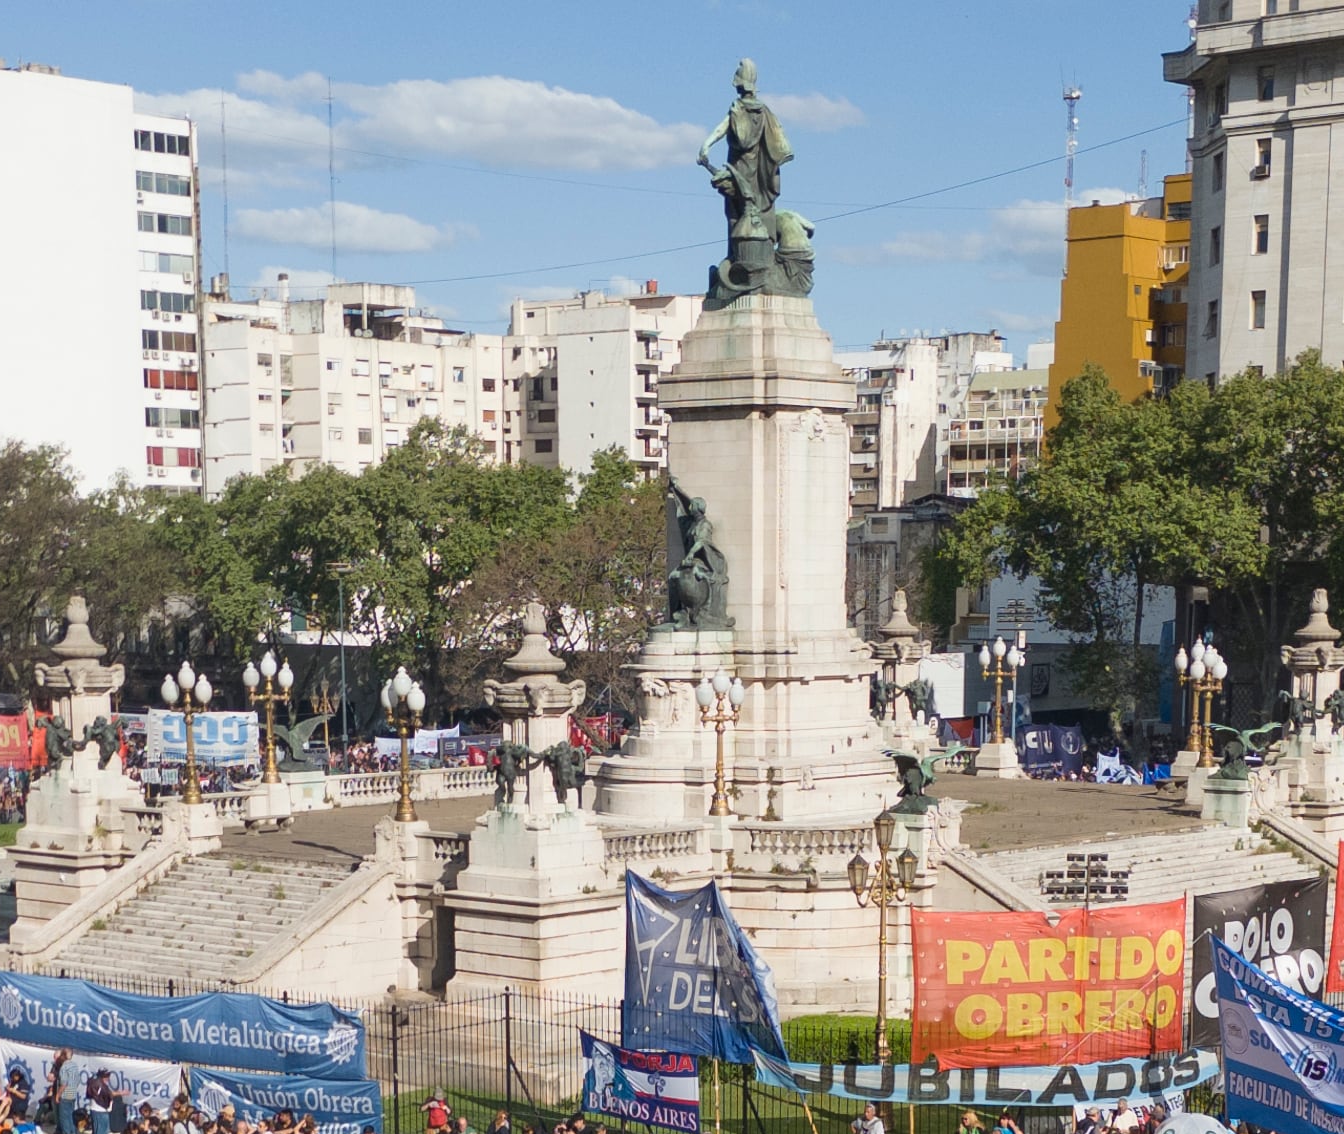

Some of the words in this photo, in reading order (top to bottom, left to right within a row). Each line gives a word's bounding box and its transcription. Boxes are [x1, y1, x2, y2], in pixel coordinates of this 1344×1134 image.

[946, 930, 1184, 987] PARTIDO
[1224, 908, 1295, 962] POLO
[1193, 949, 1324, 1019] OERO
[23, 1002, 92, 1034] Unión
[97, 1012, 175, 1044] Obrera
[179, 1017, 322, 1058] Metalúrgica
[955, 984, 1178, 1041] OBRERO
[108, 1070, 170, 1099] Obrera
[237, 1084, 301, 1110] Unión
[304, 1087, 374, 1116] Obrera
[793, 1047, 1203, 1105] JUBILADOS
[1228, 1072, 1293, 1114] FACULTAD
[1294, 1093, 1309, 1121] DE
[588, 1093, 651, 1122] BUENOS
[652, 1104, 698, 1132] AIRES
